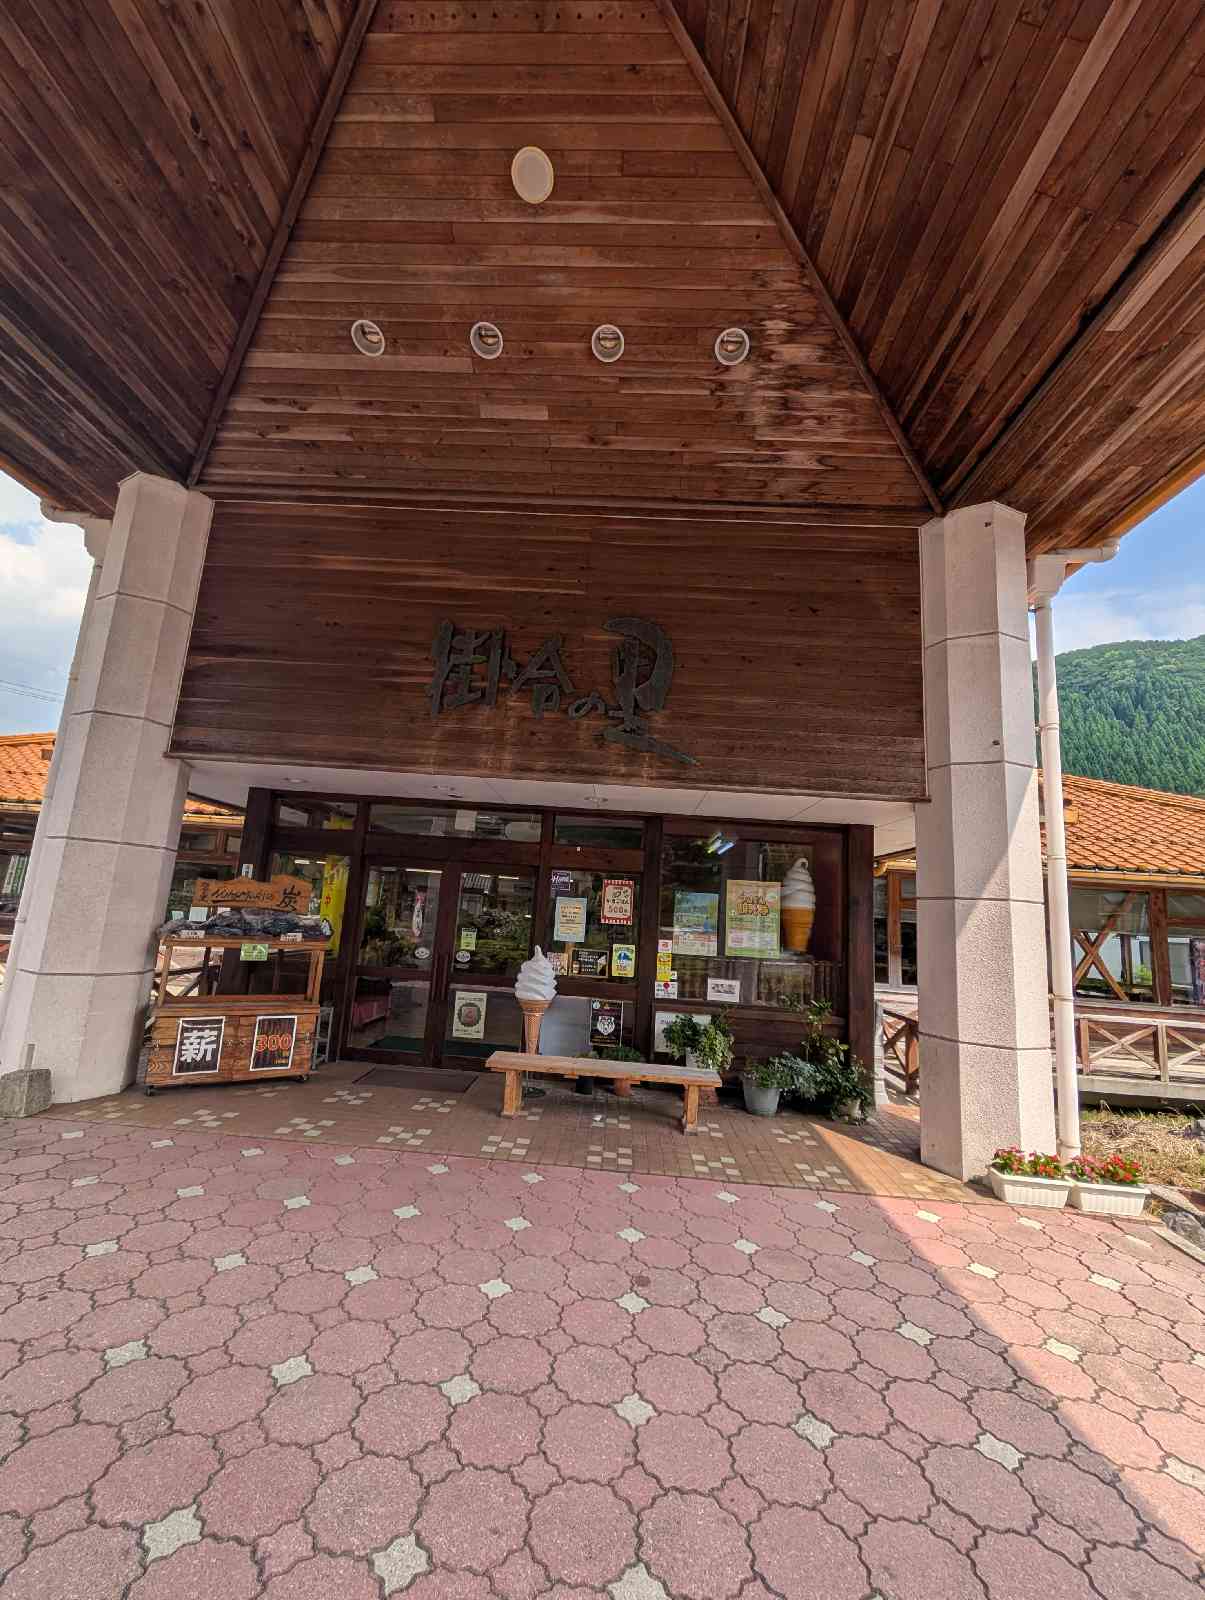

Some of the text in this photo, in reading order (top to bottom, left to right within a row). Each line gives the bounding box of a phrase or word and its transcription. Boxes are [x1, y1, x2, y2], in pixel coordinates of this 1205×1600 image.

[426, 616, 700, 766] 掛合の里
[276, 884, 302, 912] 炭
[180, 1029, 218, 1063] 薪
